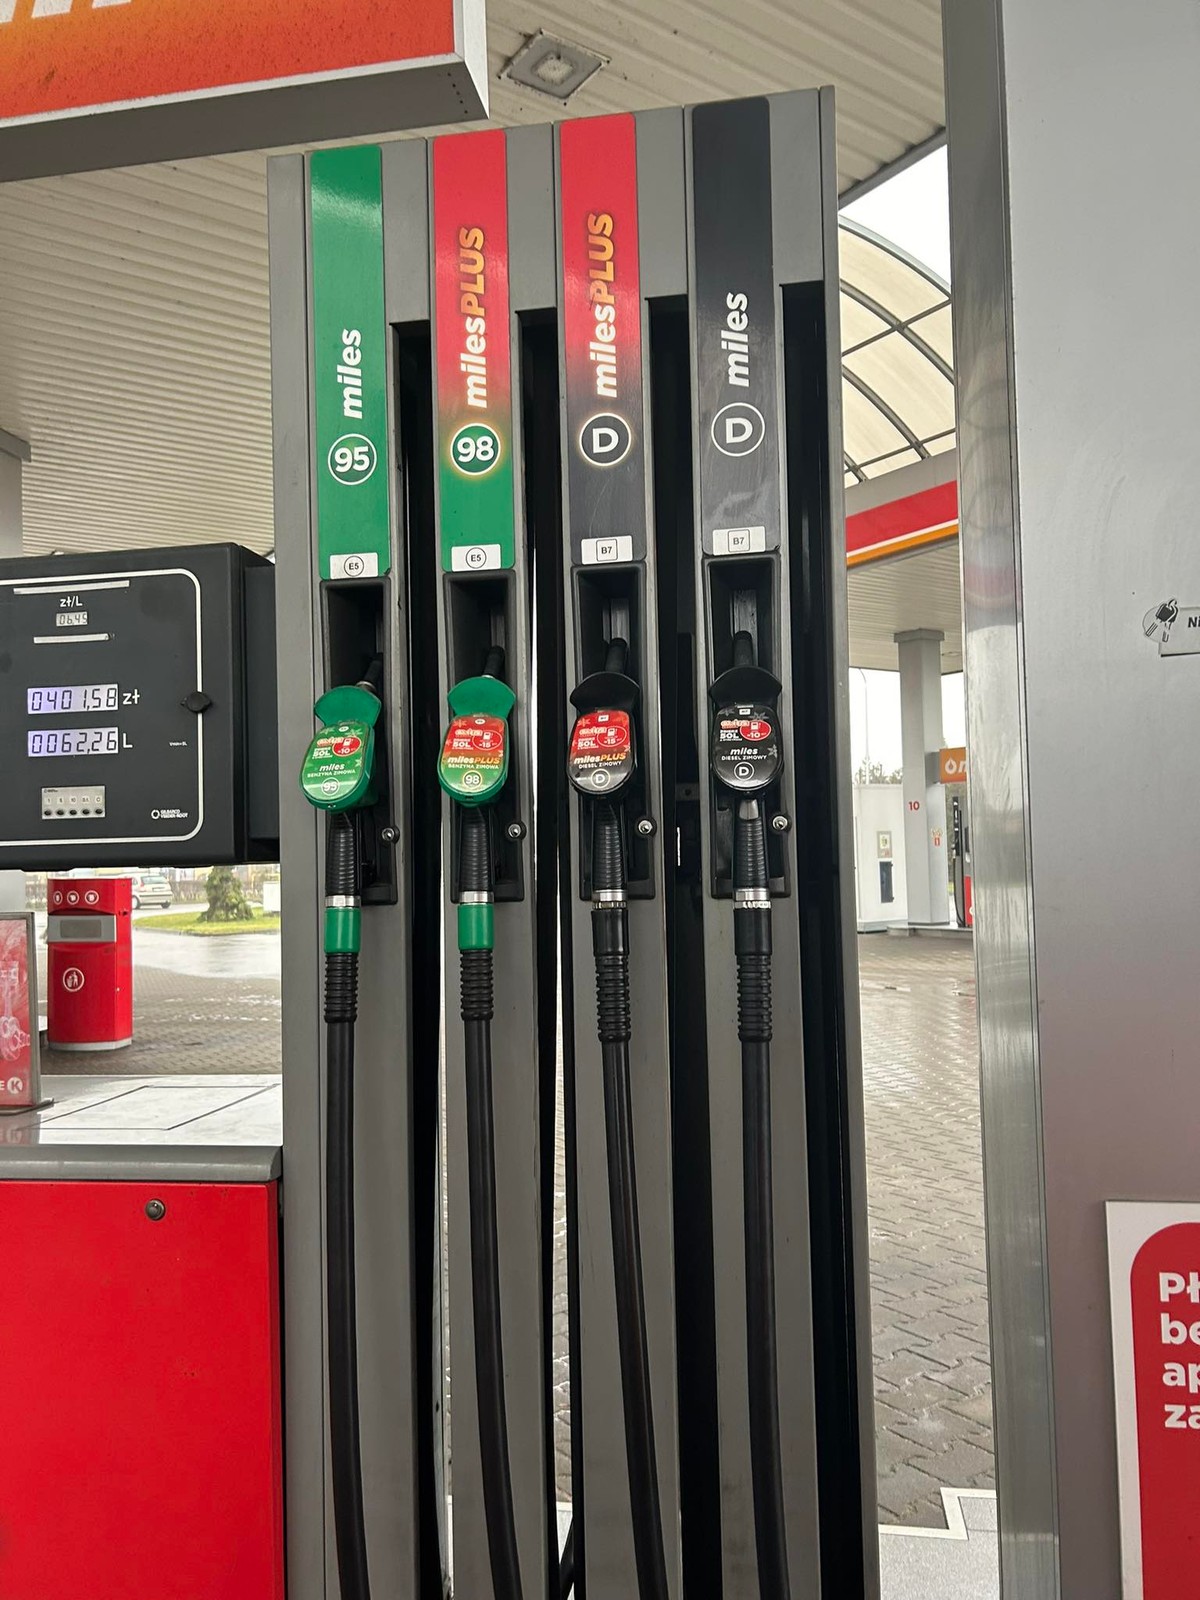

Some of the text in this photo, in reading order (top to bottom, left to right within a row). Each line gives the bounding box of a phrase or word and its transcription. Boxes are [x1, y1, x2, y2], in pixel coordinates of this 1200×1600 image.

[587, 212, 618, 398] milesPLUS
[459, 227, 488, 408] milesPLUS
[721, 292, 750, 387] miles
[336, 328, 363, 419] miles
[725, 417, 753, 444] D
[592, 427, 619, 454] D
[457, 435, 495, 463] 98
[334, 446, 370, 473] 95
[733, 536, 745, 545] B7
[601, 546, 613, 554] B7
[470, 554, 482, 562] E5
[348, 562, 360, 570] E5
[122, 732, 133, 748] L
[730, 747, 759, 756] miles
[447, 755, 501, 764] milesPLUS
[573, 752, 627, 765] milesPLUS
[319, 763, 346, 772] miles
[578, 762, 598, 770] DIESEL
[738, 766, 750, 777] D
[465, 774, 480, 785] 98
[595, 773, 606, 784] D
[908, 800, 920, 811] 10
